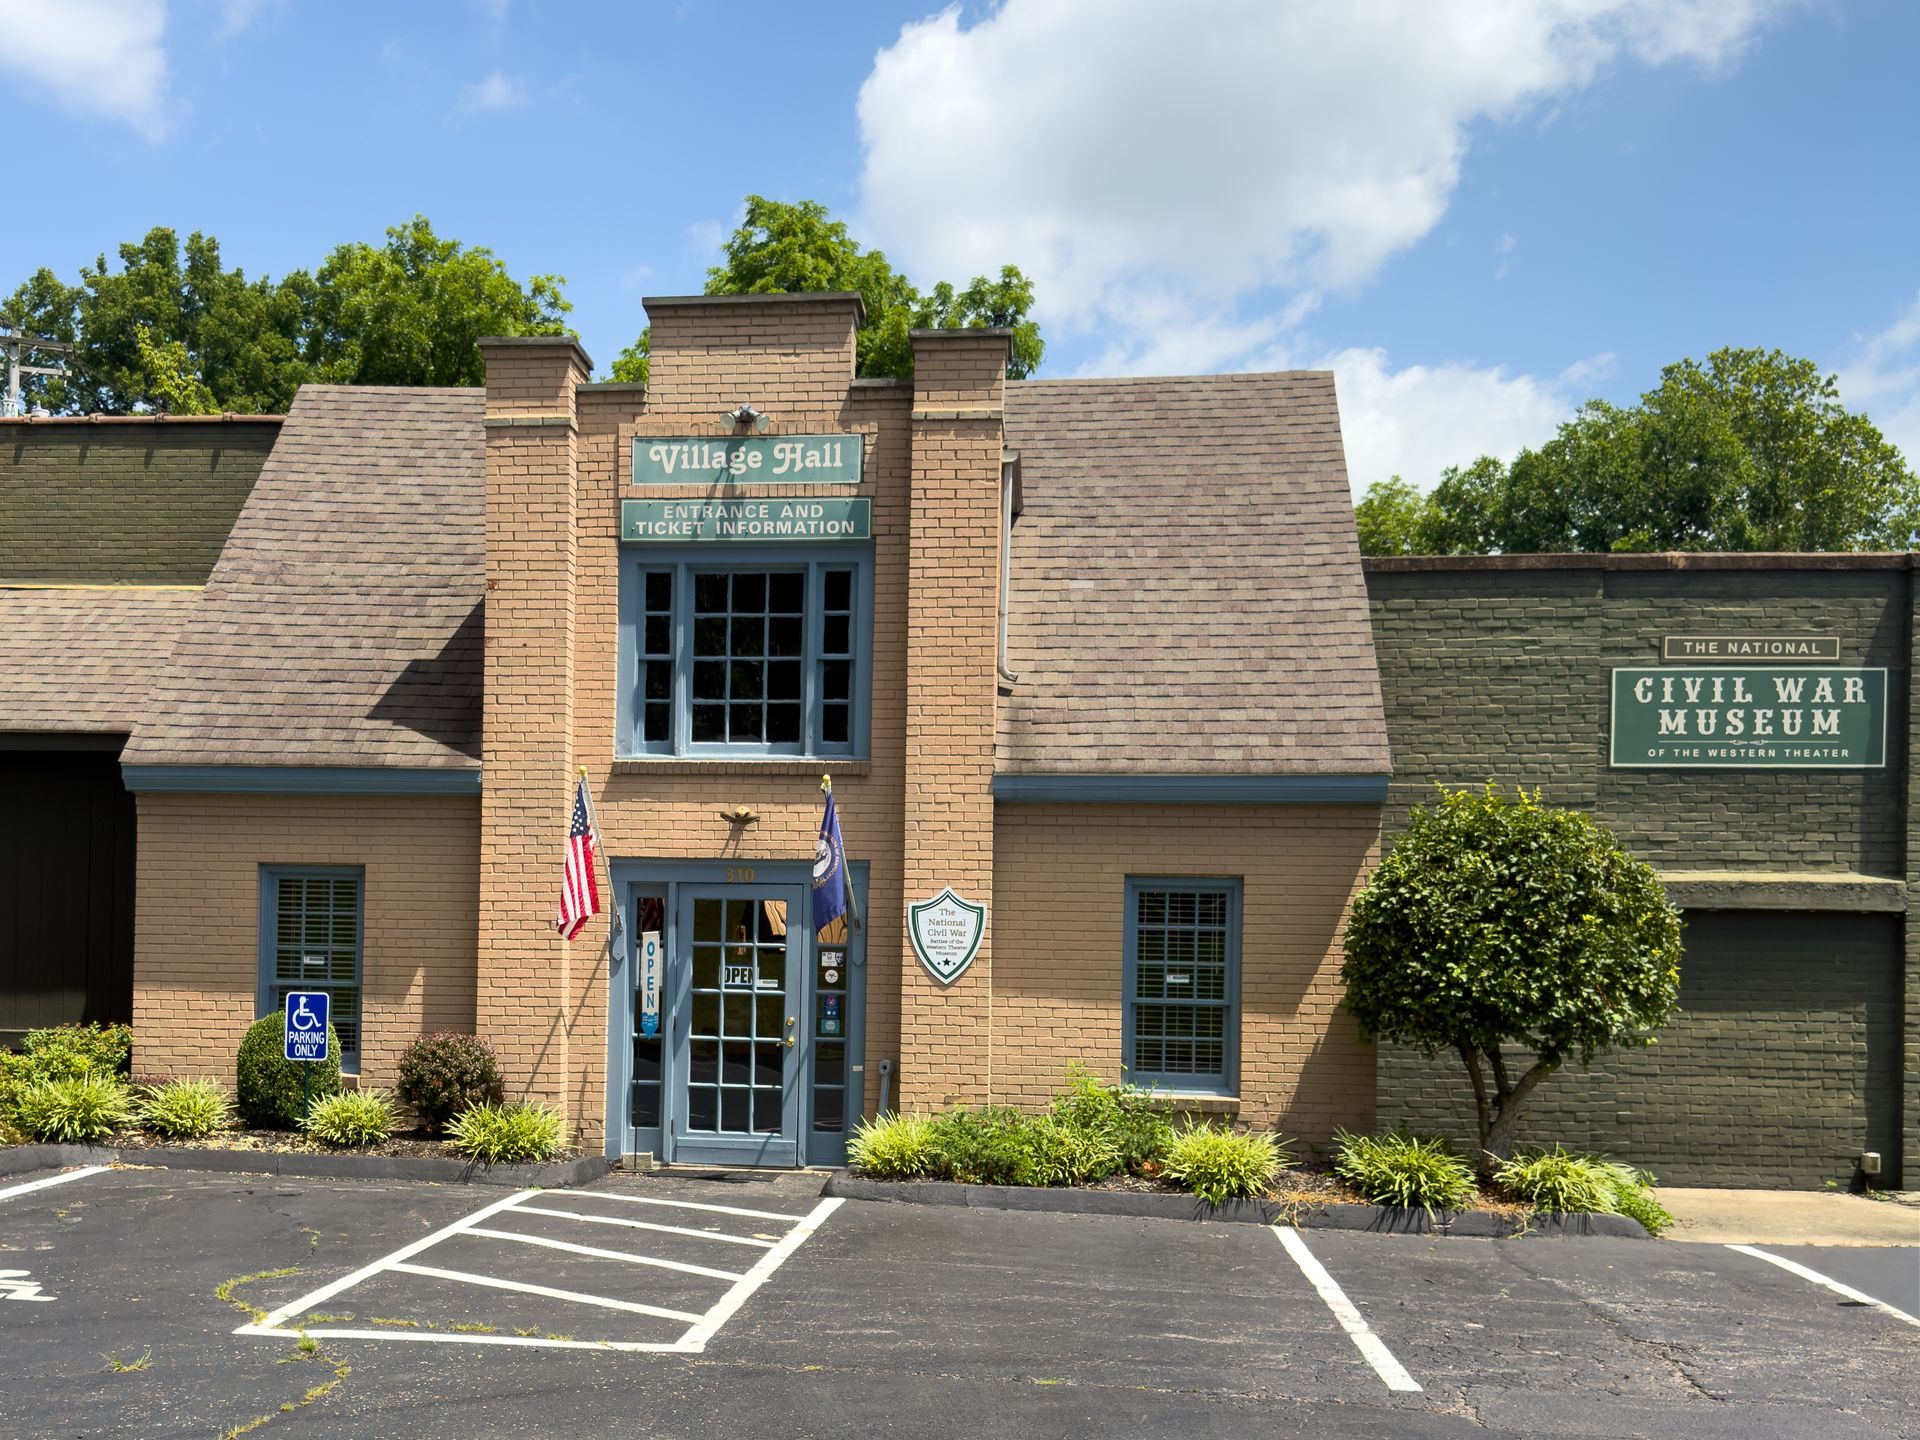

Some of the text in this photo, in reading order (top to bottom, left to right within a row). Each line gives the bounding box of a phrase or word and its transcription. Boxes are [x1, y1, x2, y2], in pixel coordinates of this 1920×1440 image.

[649, 442, 842, 475] Village Hall
[663, 504, 824, 519] ENTRANCE AND
[635, 520, 855, 535] TICKET INFORMATION
[1683, 642, 1821, 654] THE NATIONAL
[1634, 677, 1866, 704] CIVIL WAR
[1657, 709, 1841, 736] MUSEUM
[1647, 749, 1849, 758] OF THE WESTERN THEATER
[726, 867, 755, 882] 310
[939, 908, 956, 916] The
[928, 918, 966, 926] National
[928, 929, 967, 937] Civil War
[646, 941, 655, 1008] OPEN
[724, 967, 753, 984] OPEN
[288, 1031, 325, 1044] PARKING
[294, 1044, 318, 1056] ONLY
